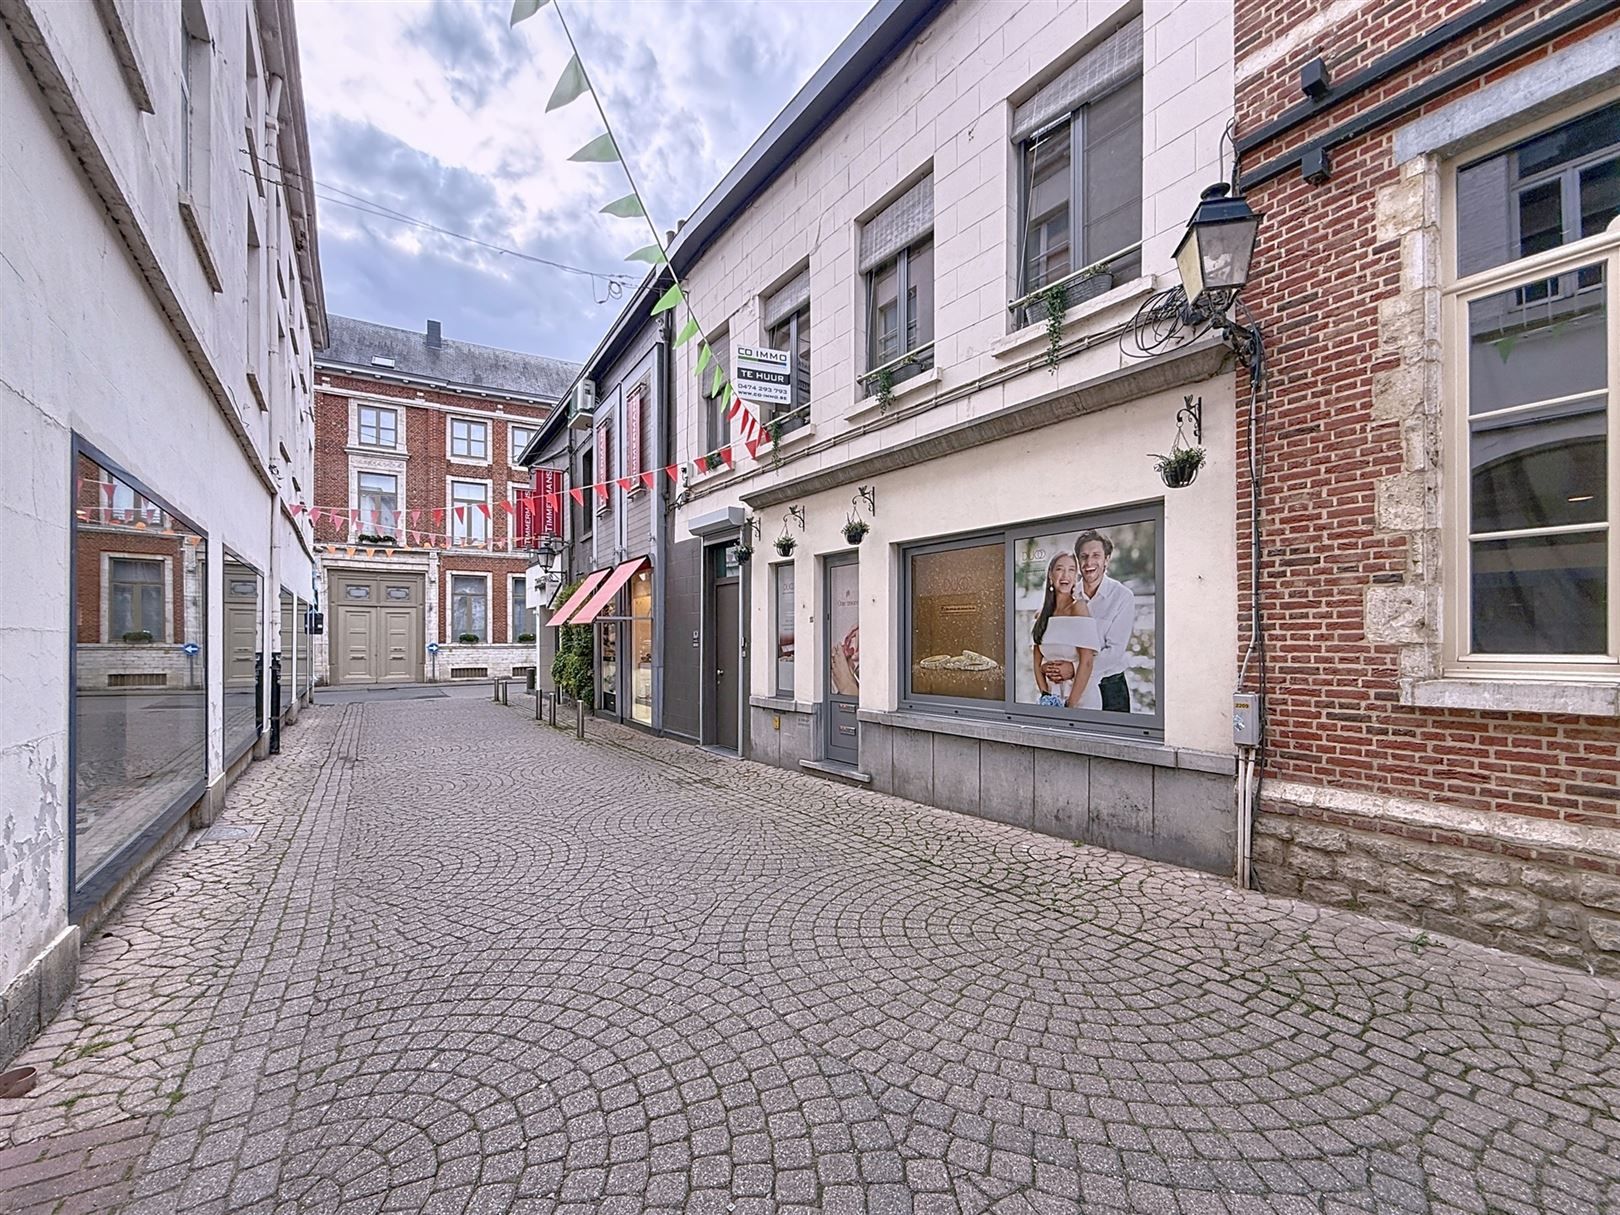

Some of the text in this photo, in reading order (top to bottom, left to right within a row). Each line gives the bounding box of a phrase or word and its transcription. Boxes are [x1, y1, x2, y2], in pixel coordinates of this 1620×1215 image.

[738, 347, 787, 362] CO IMMO
[740, 369, 785, 383] TE HUUR
[737, 383, 757, 391] 0474
